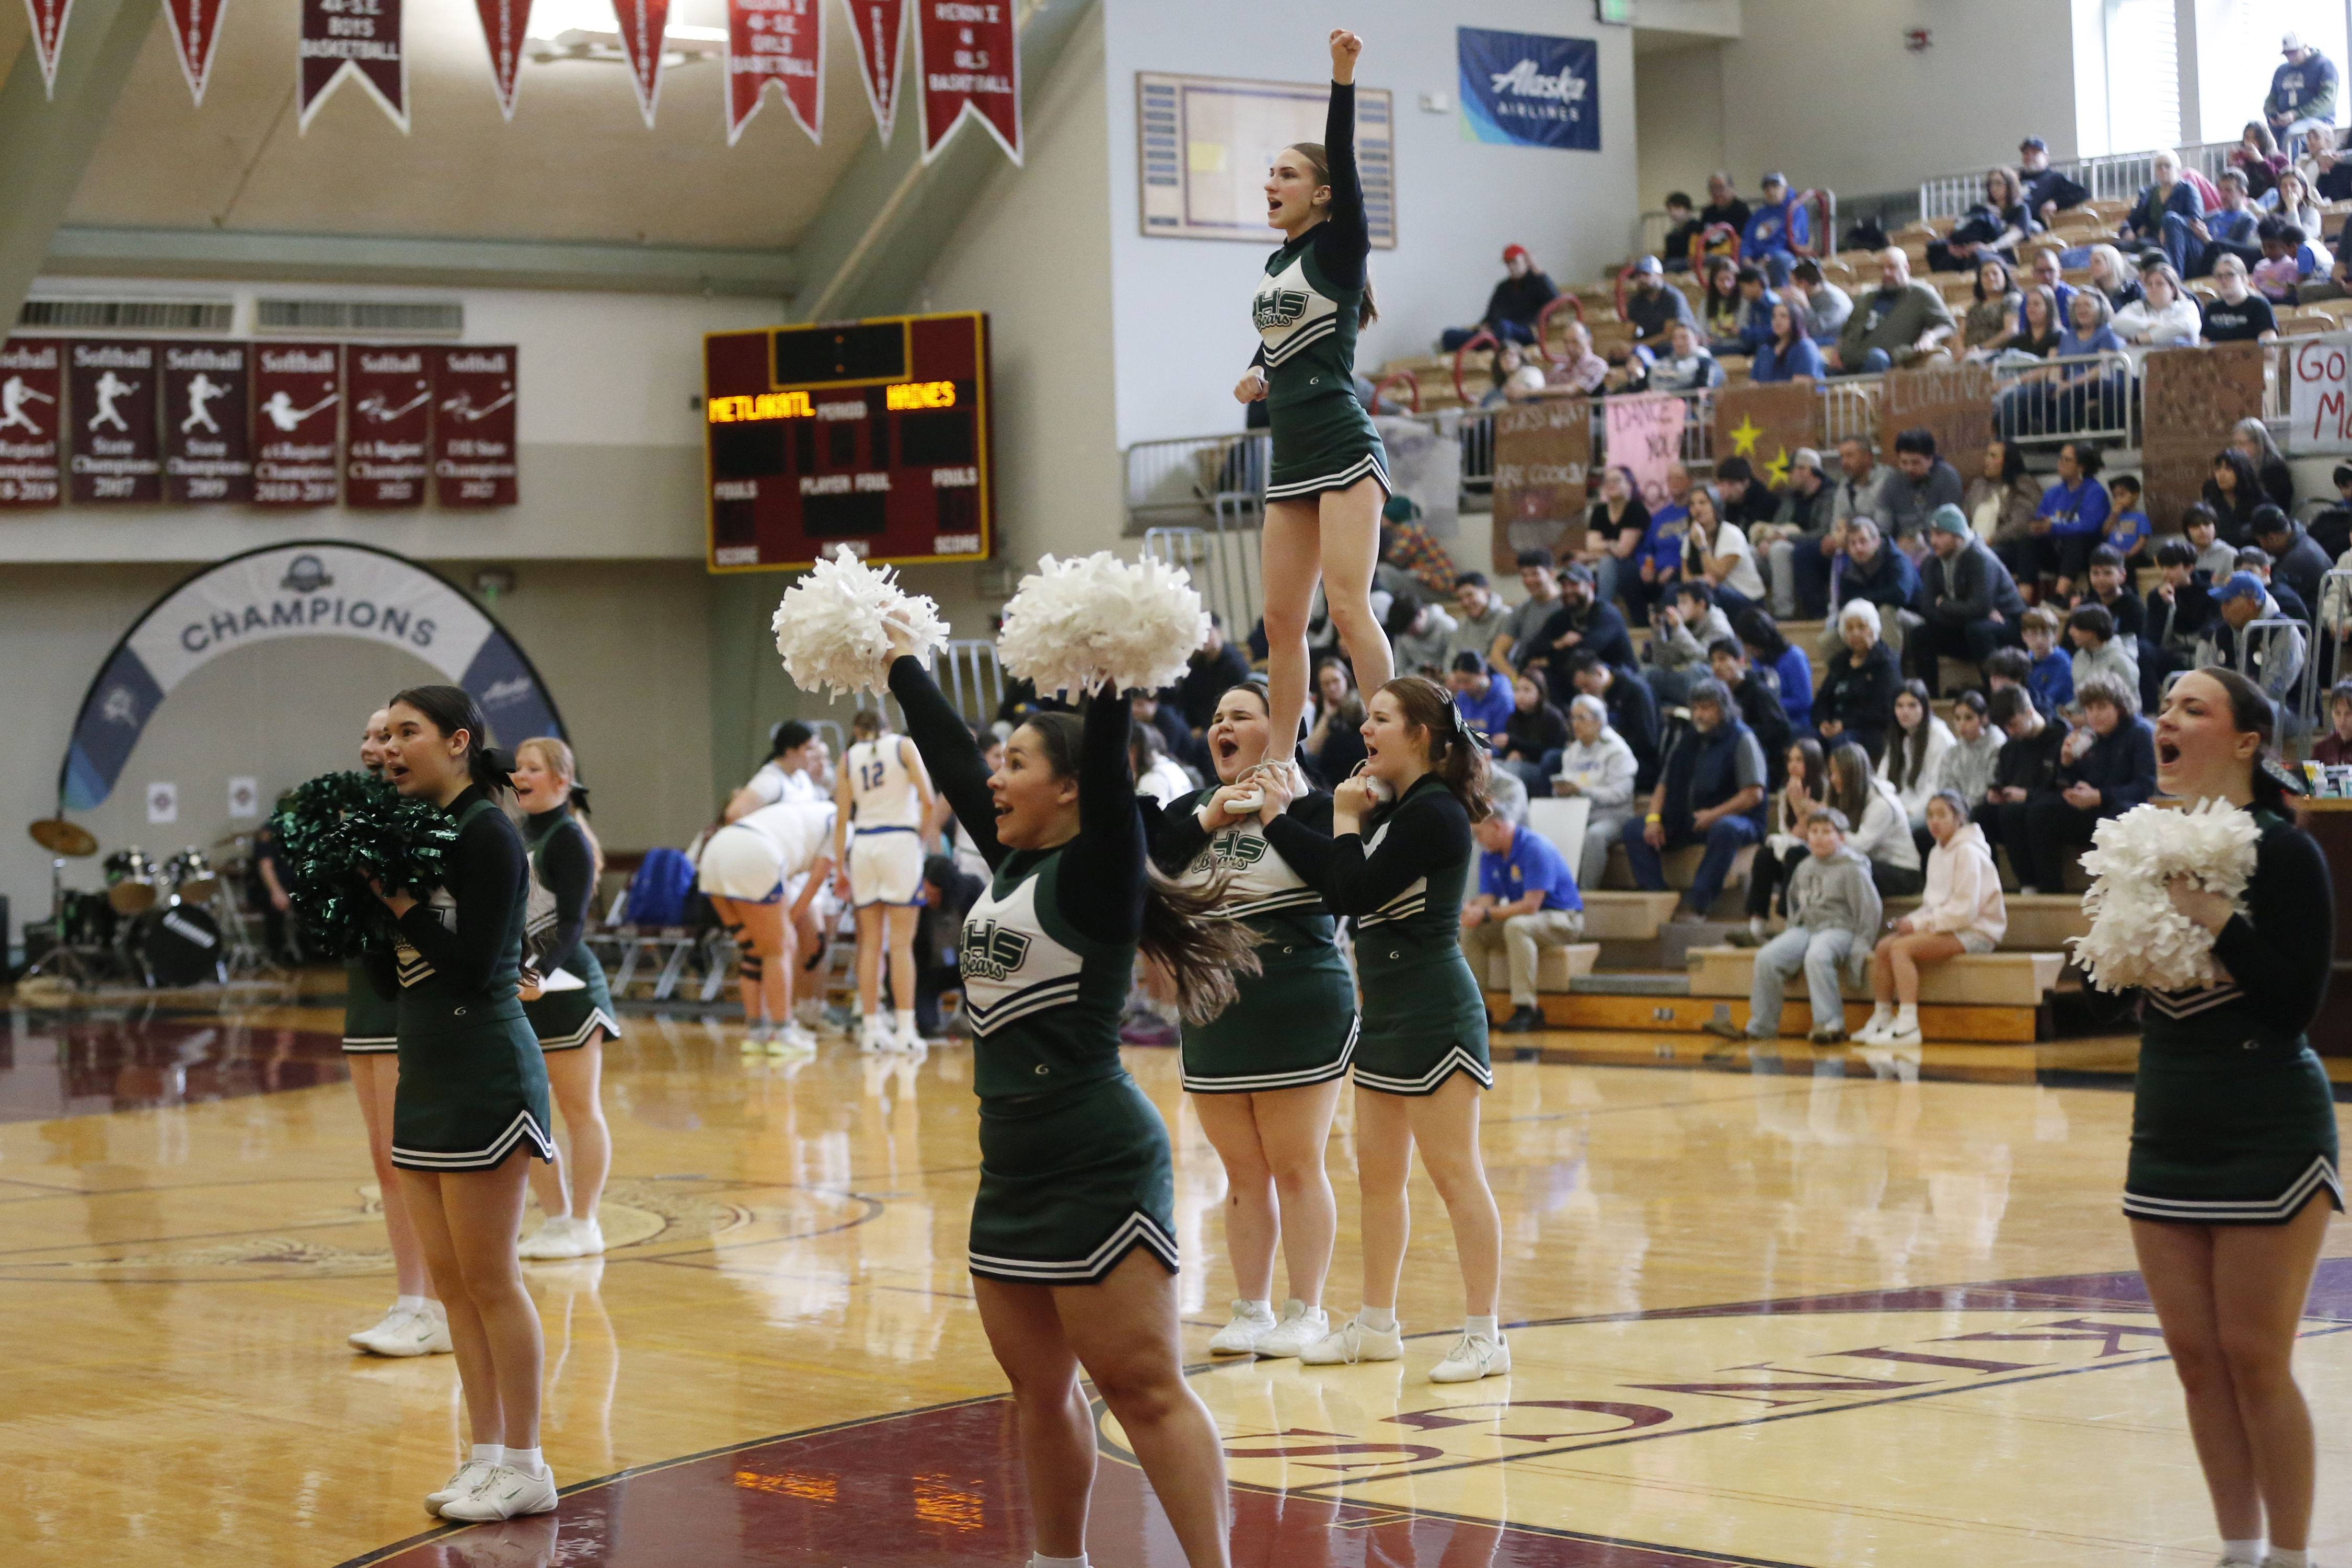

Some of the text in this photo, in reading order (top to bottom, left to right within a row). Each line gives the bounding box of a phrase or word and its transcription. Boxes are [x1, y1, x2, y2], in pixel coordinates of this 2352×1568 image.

[1491, 58, 1587, 104] Alaska
[1497, 101, 1580, 122] AIRLINES
[74, 345, 151, 368] Softball
[166, 348, 243, 371] Softball
[261, 350, 335, 373] Softball
[360, 353, 421, 373] Softball
[446, 353, 508, 373] Softball
[816, 401, 867, 420] PERIOD
[799, 475, 852, 494] PLAYER
[932, 467, 978, 487] FOULS
[714, 480, 758, 500] FOULS
[934, 534, 981, 554] SCORE
[716, 546, 759, 565] SCORE
[181, 596, 436, 652] CHAMPIONS
[861, 762, 884, 791] 12
[961, 919, 1032, 972] HS
